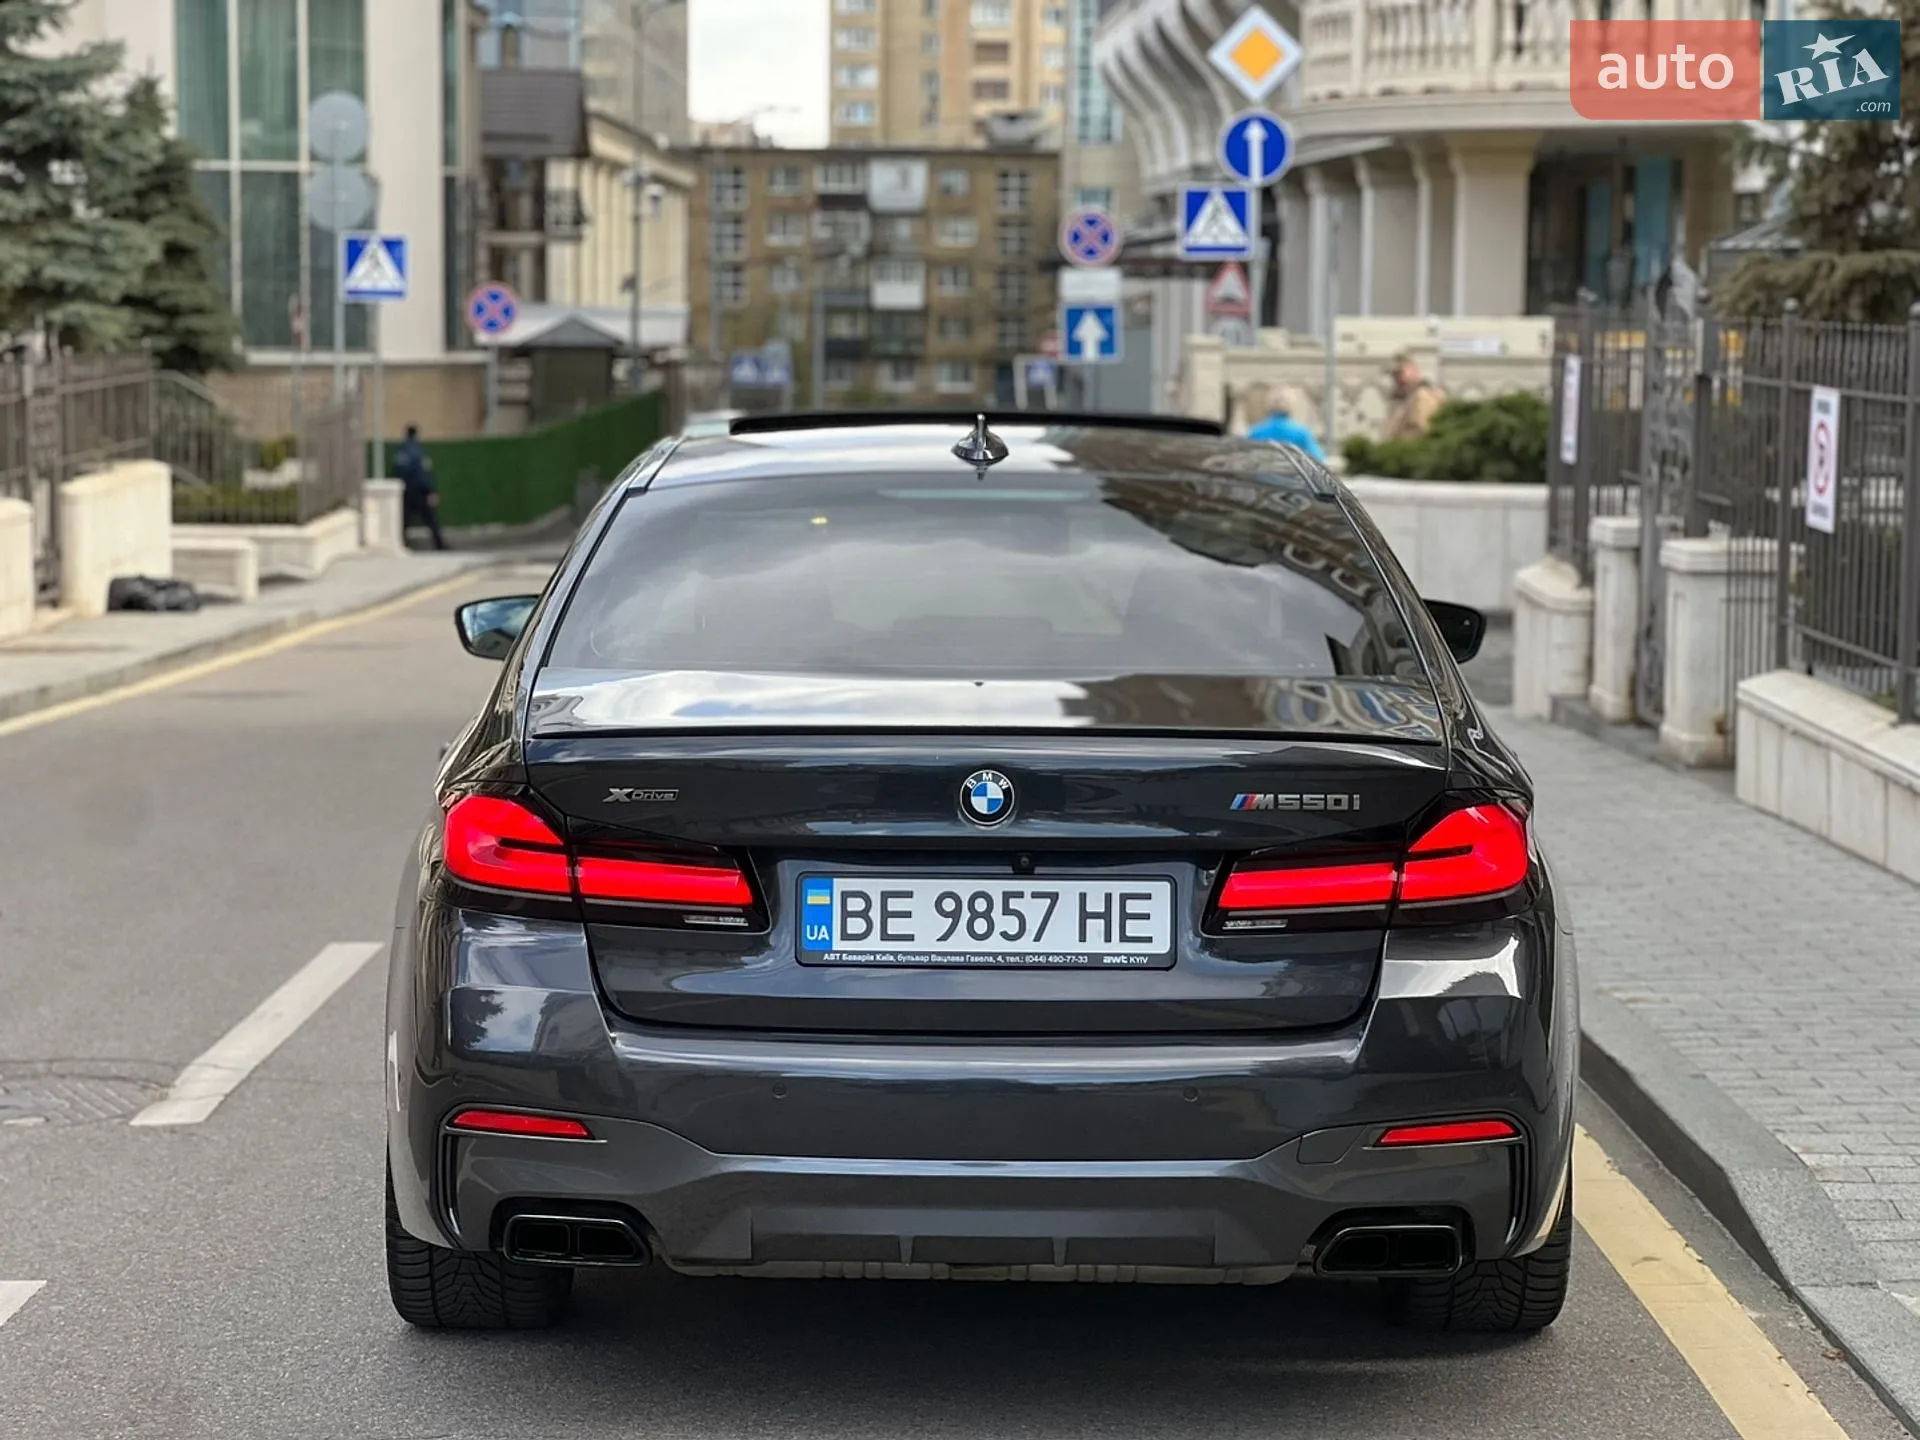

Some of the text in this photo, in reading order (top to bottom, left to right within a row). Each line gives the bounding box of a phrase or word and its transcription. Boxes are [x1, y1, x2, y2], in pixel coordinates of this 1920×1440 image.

[966, 772, 1010, 790] BMW
[840, 890, 1153, 943] BE 9857 HE
[806, 925, 829, 940] UA
